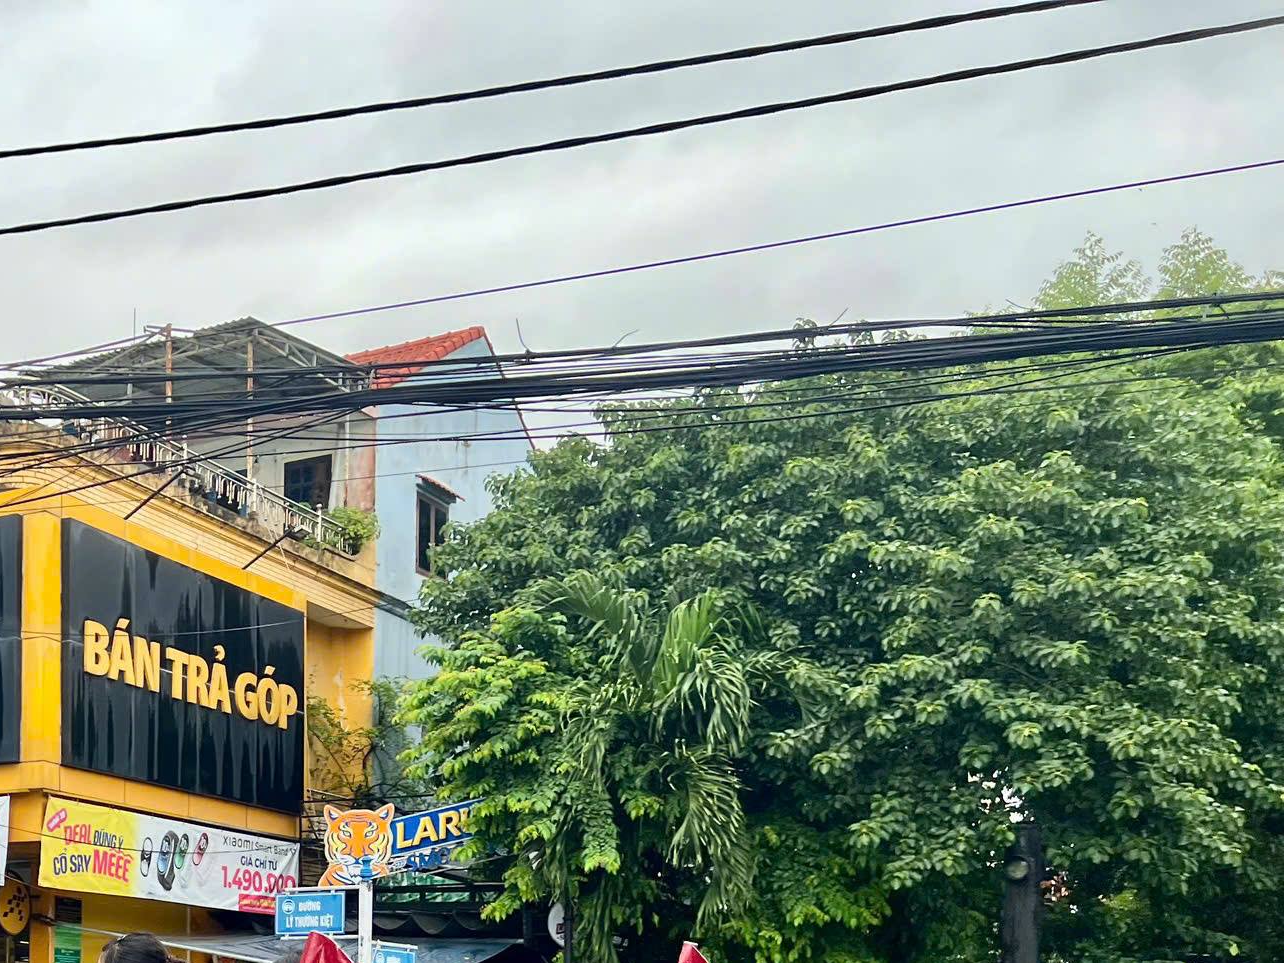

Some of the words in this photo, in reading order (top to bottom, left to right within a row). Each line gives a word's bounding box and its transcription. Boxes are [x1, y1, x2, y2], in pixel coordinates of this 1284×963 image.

[84, 618, 161, 693] BÁN
[166, 645, 232, 714] TRẢ
[234, 665, 298, 730] GÓP
[70, 854, 92, 873] SAY
